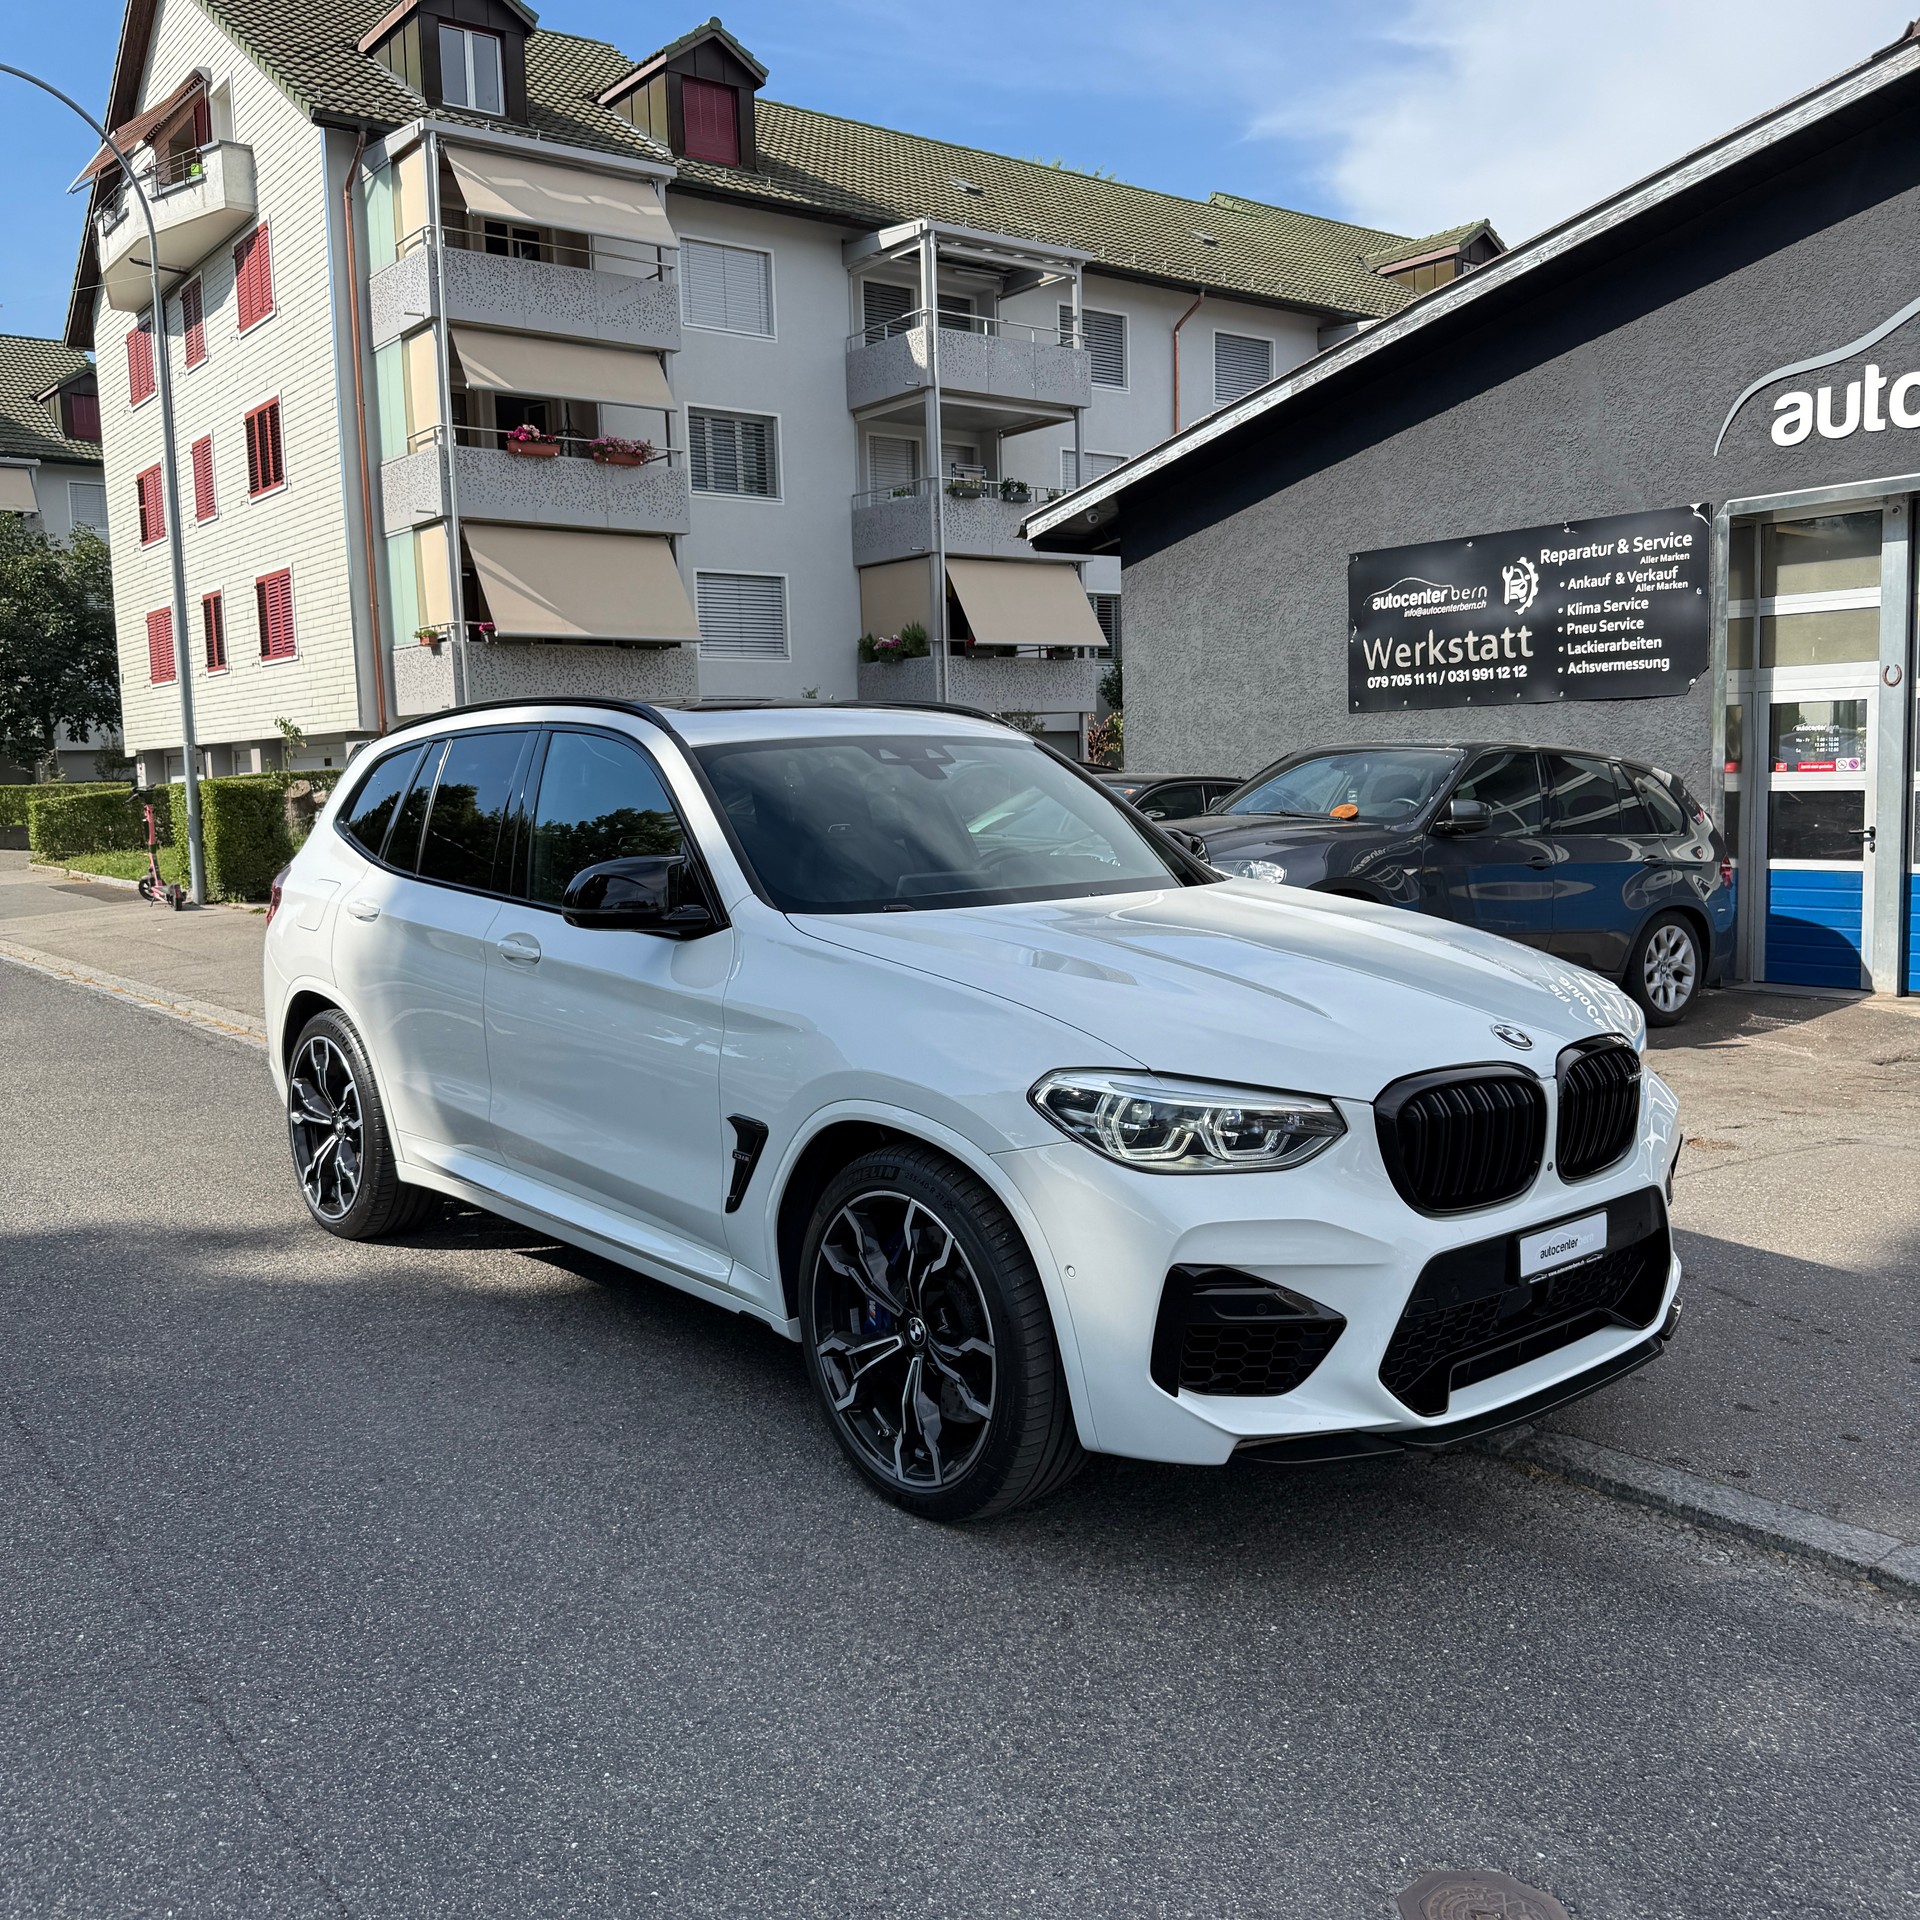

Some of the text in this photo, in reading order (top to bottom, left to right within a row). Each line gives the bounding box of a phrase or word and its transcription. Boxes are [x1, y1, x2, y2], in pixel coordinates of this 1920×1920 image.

[1540, 532, 1693, 566] Reparatur & Service
[1640, 552, 1690, 565] Aller Marken
[1567, 565, 1679, 590] Ankauf & Verkauf
[1635, 580, 1688, 593] Aller Marken
[1403, 599, 1487, 618] info@autocenterbern.ch
[1567, 597, 1649, 616] Klima Service
[1567, 616, 1645, 635] Pneu Service
[1362, 625, 1534, 671] Werkstatt
[1567, 636, 1662, 655] Lackierarbeiten
[1567, 657, 1670, 674] Achsvermessung
[1367, 665, 1528, 689] 079 705 11 11 / 031 991 12 12
[1540, 1238, 1578, 1259] autocenter
